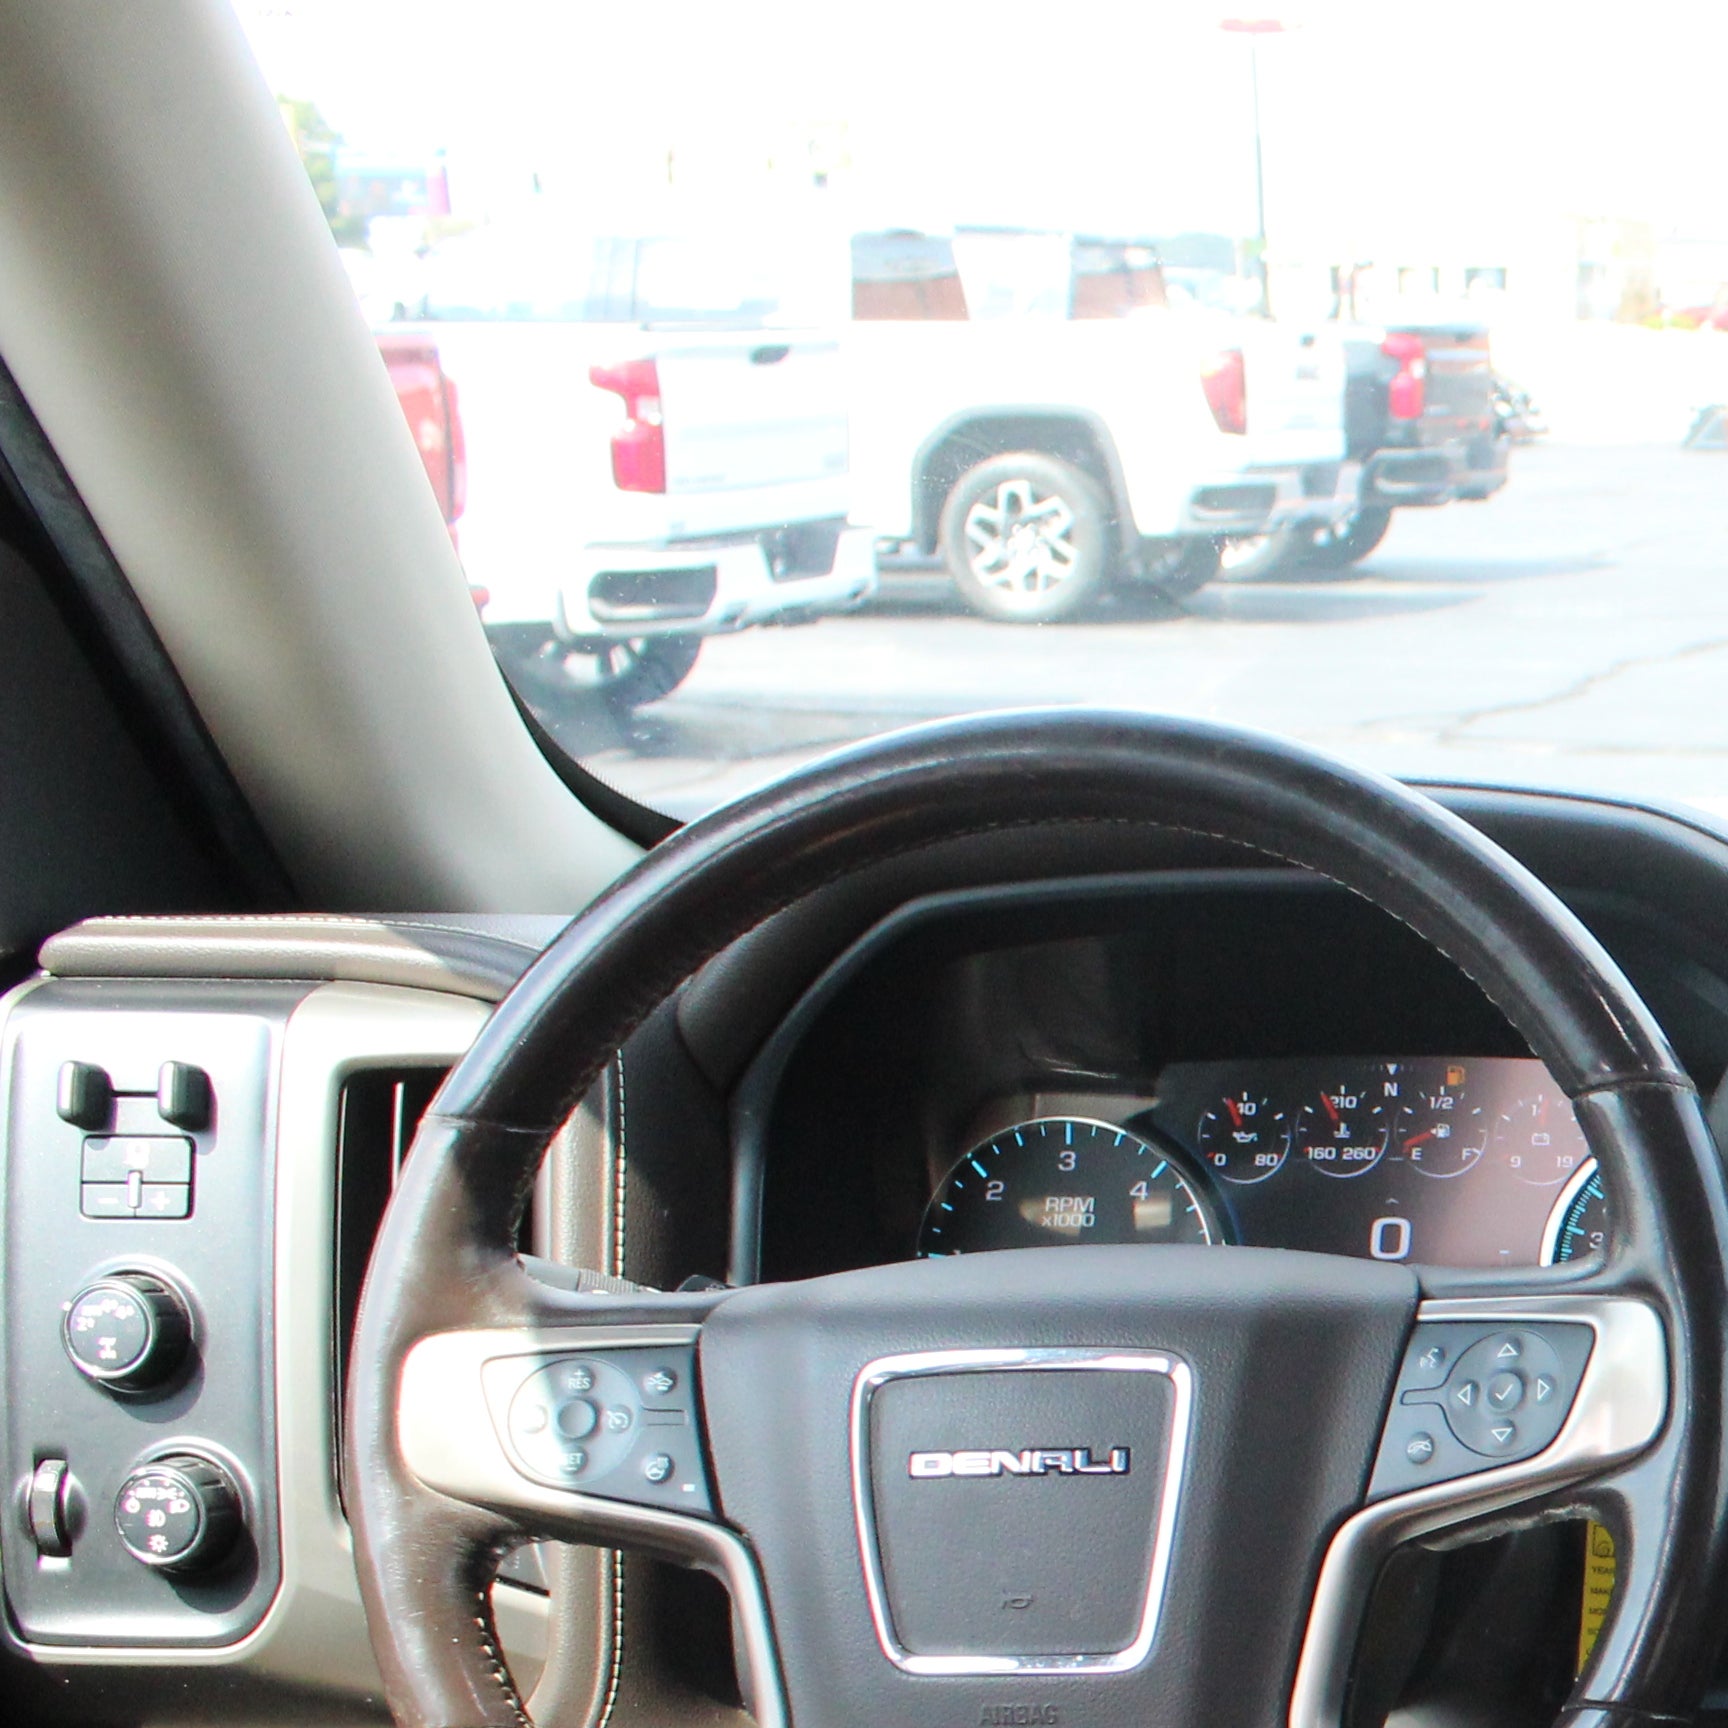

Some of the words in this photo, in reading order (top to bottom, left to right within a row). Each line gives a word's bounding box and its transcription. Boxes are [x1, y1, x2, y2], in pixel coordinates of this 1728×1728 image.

[1384, 1083, 1398, 1096] N
[1429, 1097, 1454, 1110] 1/2
[1214, 1153, 1227, 1167] 0
[1255, 1153, 1278, 1167] 80
[1308, 1147, 1336, 1160] 160
[1342, 1147, 1376, 1160] 260
[1411, 1148, 1422, 1160] E
[1058, 1151, 1077, 1172] 3
[1556, 1157, 1573, 1168] 19
[986, 1181, 1004, 1201] 2
[1129, 1181, 1149, 1201] 4
[1045, 1197, 1095, 1213] RPM
[1369, 1216, 1411, 1260] 0
[567, 1377, 591, 1390] RES
[909, 1446, 1132, 1480] DENALI
[979, 1703, 1059, 1726] AIRBAG
